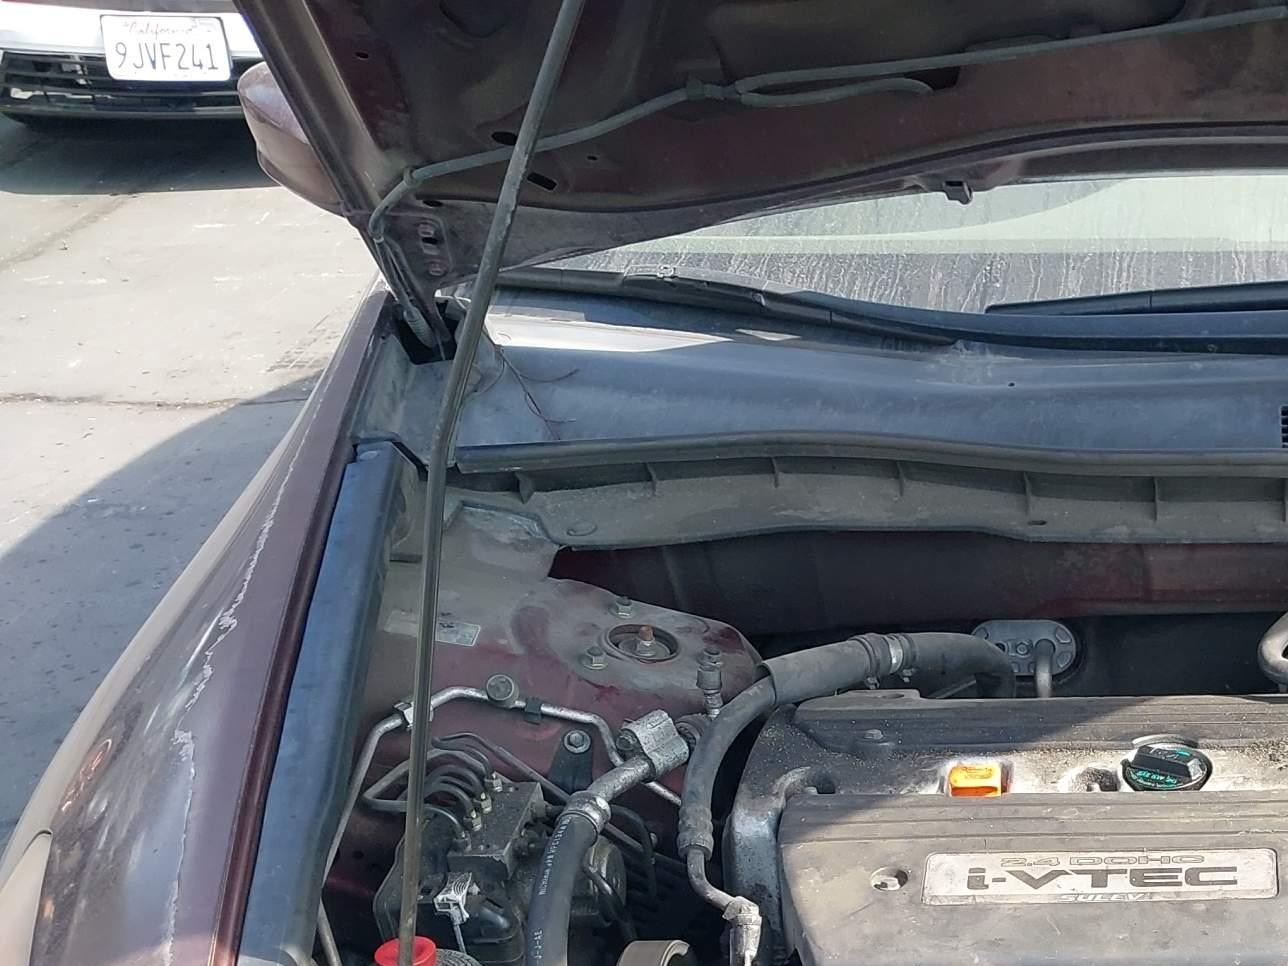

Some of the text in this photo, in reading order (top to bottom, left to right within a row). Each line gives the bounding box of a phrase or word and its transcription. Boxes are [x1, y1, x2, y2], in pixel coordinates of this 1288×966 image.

[115, 41, 219, 71] 9JVF241
[1000, 854, 1205, 867] 2.4 DOHC
[966, 866, 1238, 890] i-VTEC
